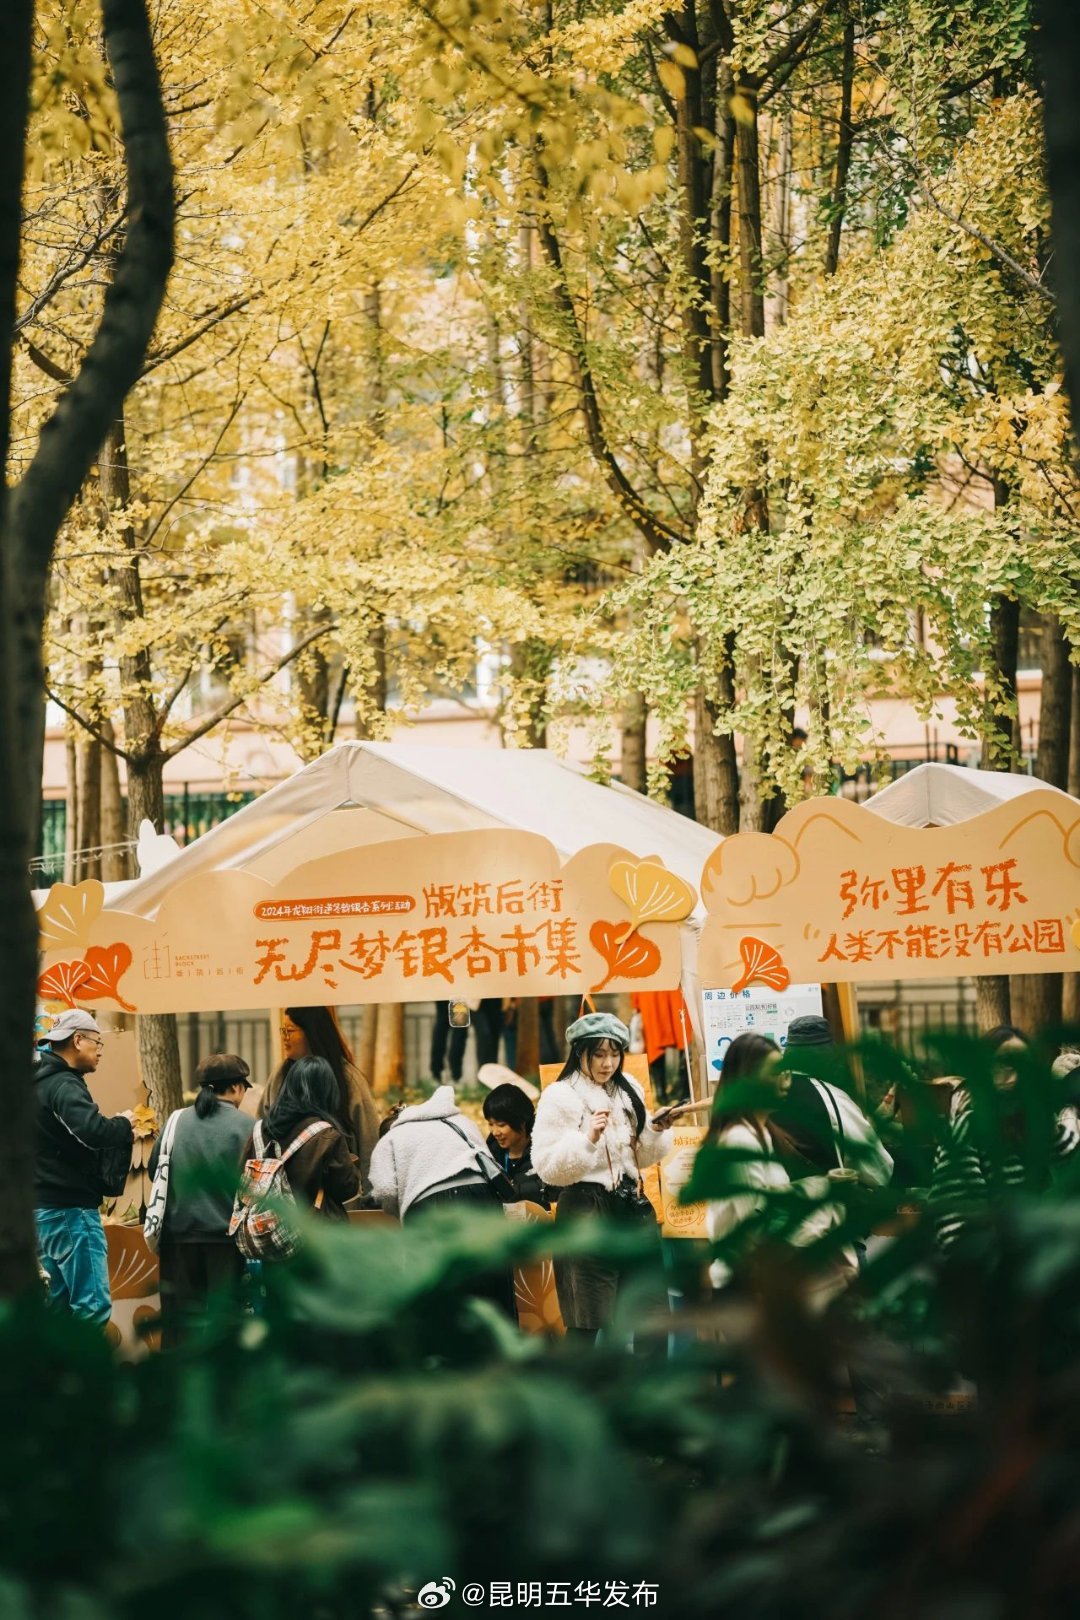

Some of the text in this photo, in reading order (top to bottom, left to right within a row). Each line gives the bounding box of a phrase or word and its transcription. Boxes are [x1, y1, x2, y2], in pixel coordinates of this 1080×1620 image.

[422, 879, 563, 919] 版筑后街
[839, 858, 1029, 920] 弥里有乐
[253, 918, 582, 989] 无尽梦银杏市集
